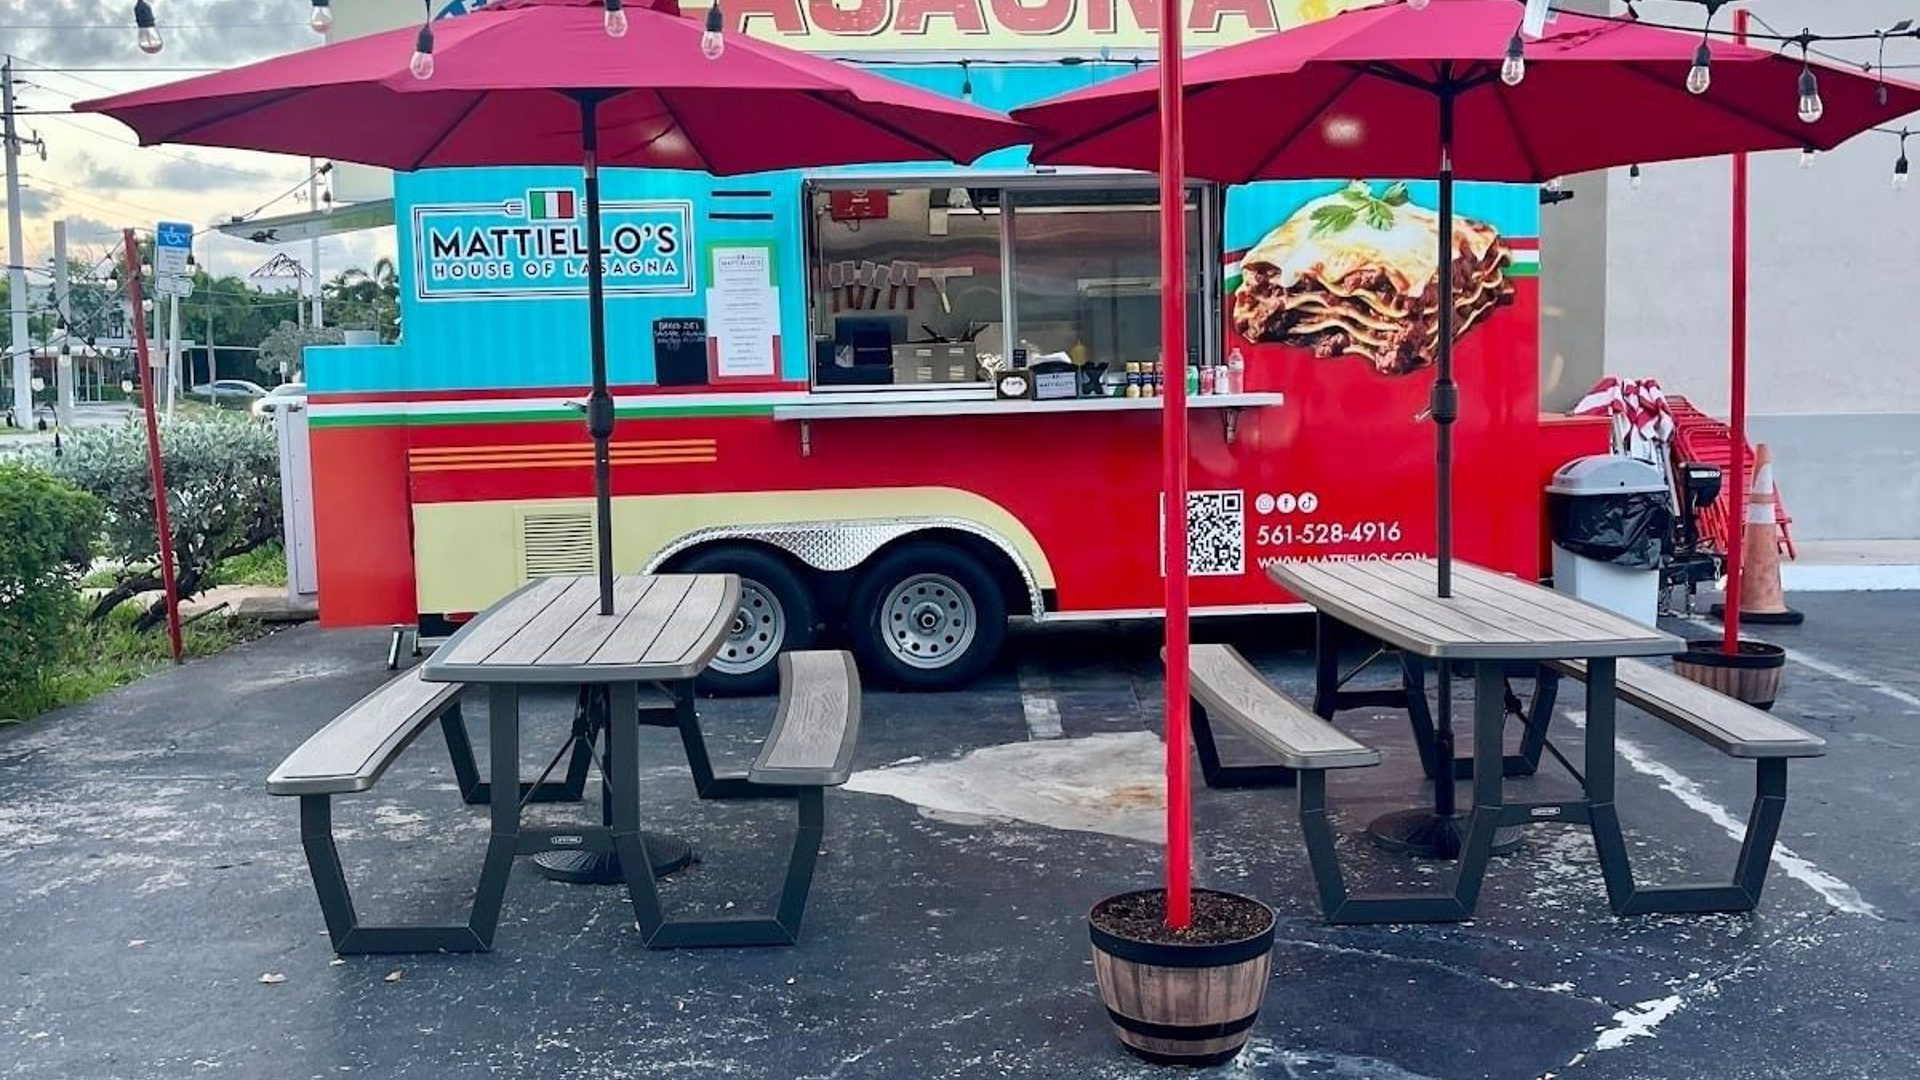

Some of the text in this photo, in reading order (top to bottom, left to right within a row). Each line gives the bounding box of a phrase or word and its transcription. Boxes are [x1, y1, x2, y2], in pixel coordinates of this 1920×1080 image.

[434, 259, 676, 277] HOUSE OF LASAGNA
[1257, 522, 1401, 545] 561-528-4916
